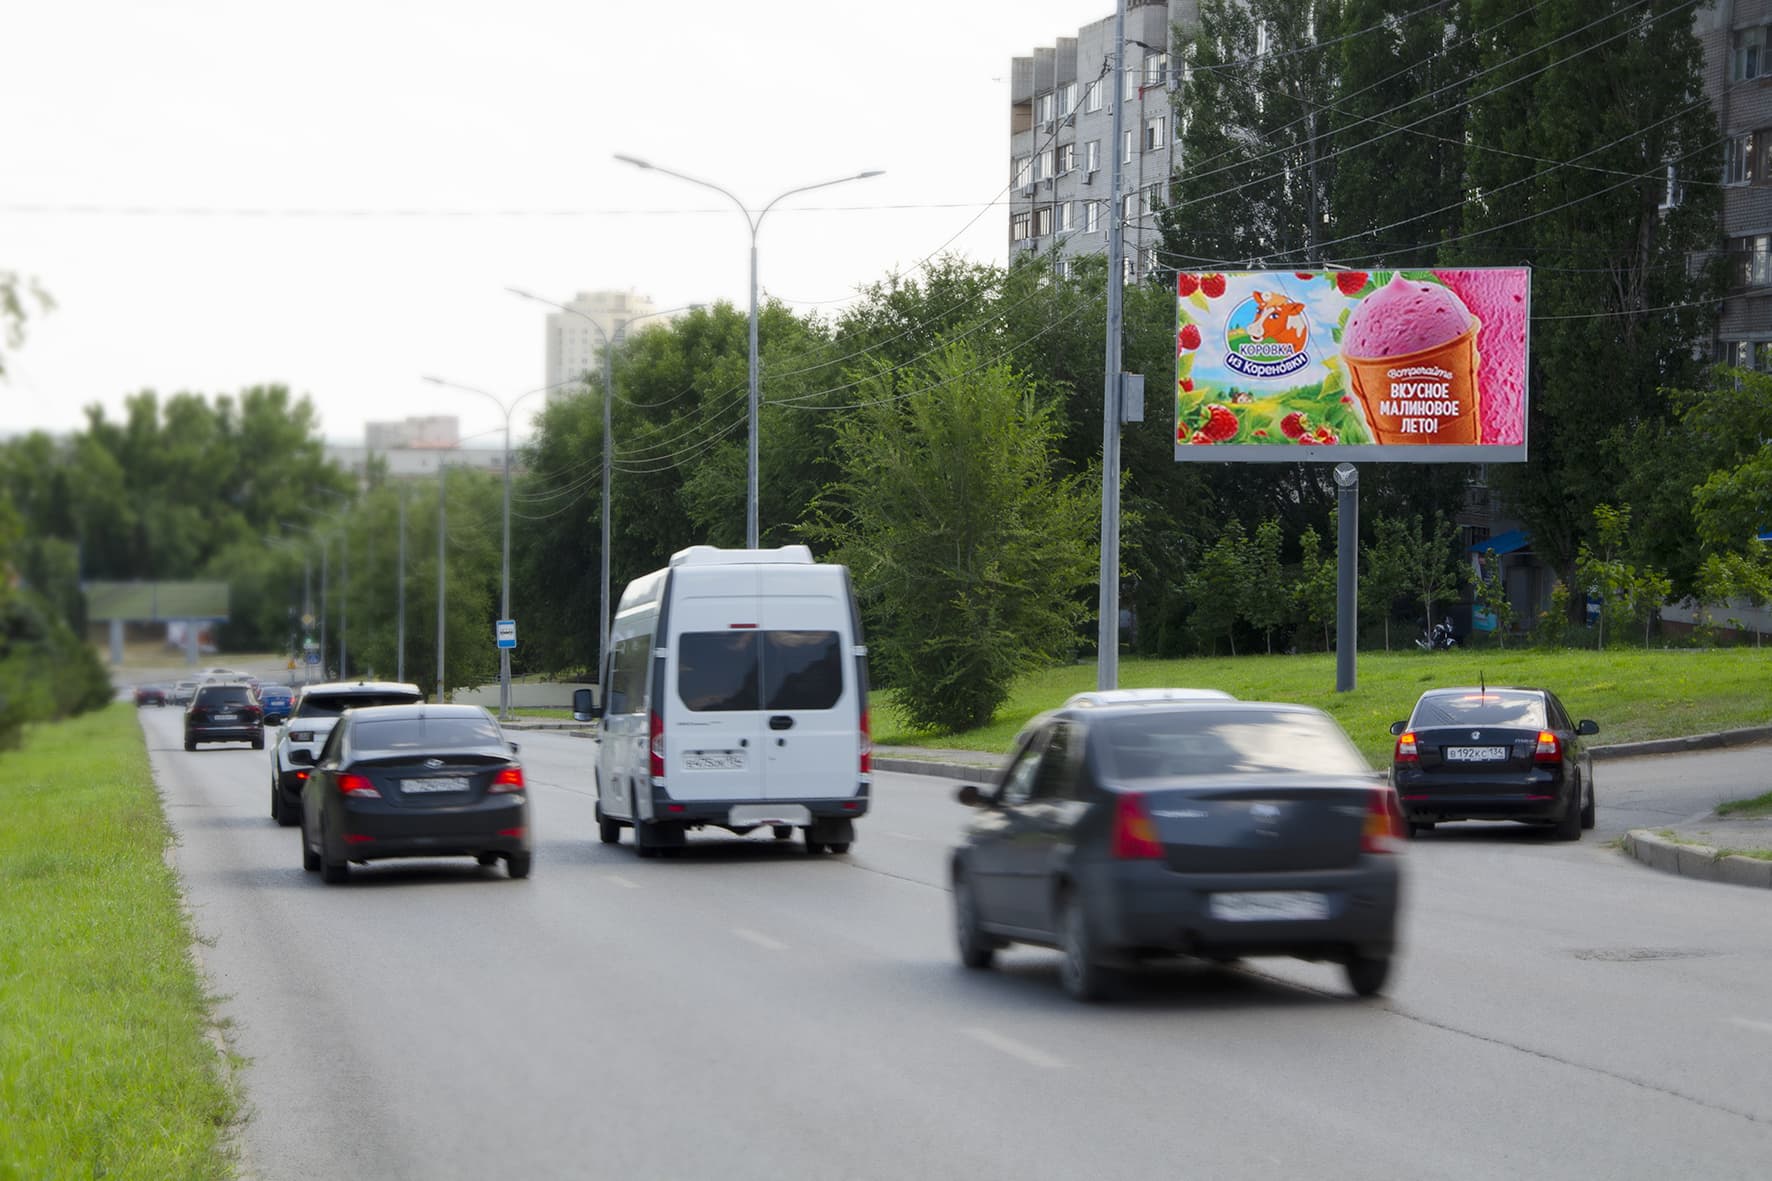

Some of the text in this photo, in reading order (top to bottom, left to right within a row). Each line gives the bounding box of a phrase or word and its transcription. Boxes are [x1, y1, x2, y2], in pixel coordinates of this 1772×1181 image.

[1240, 344, 1294, 355] КОРОВКА
[1390, 383, 1449, 398] ВКУСНОЕ
[1379, 400, 1460, 416] МАЛИНОВОЕ
[1400, 418, 1438, 433] ЛЕТО!
